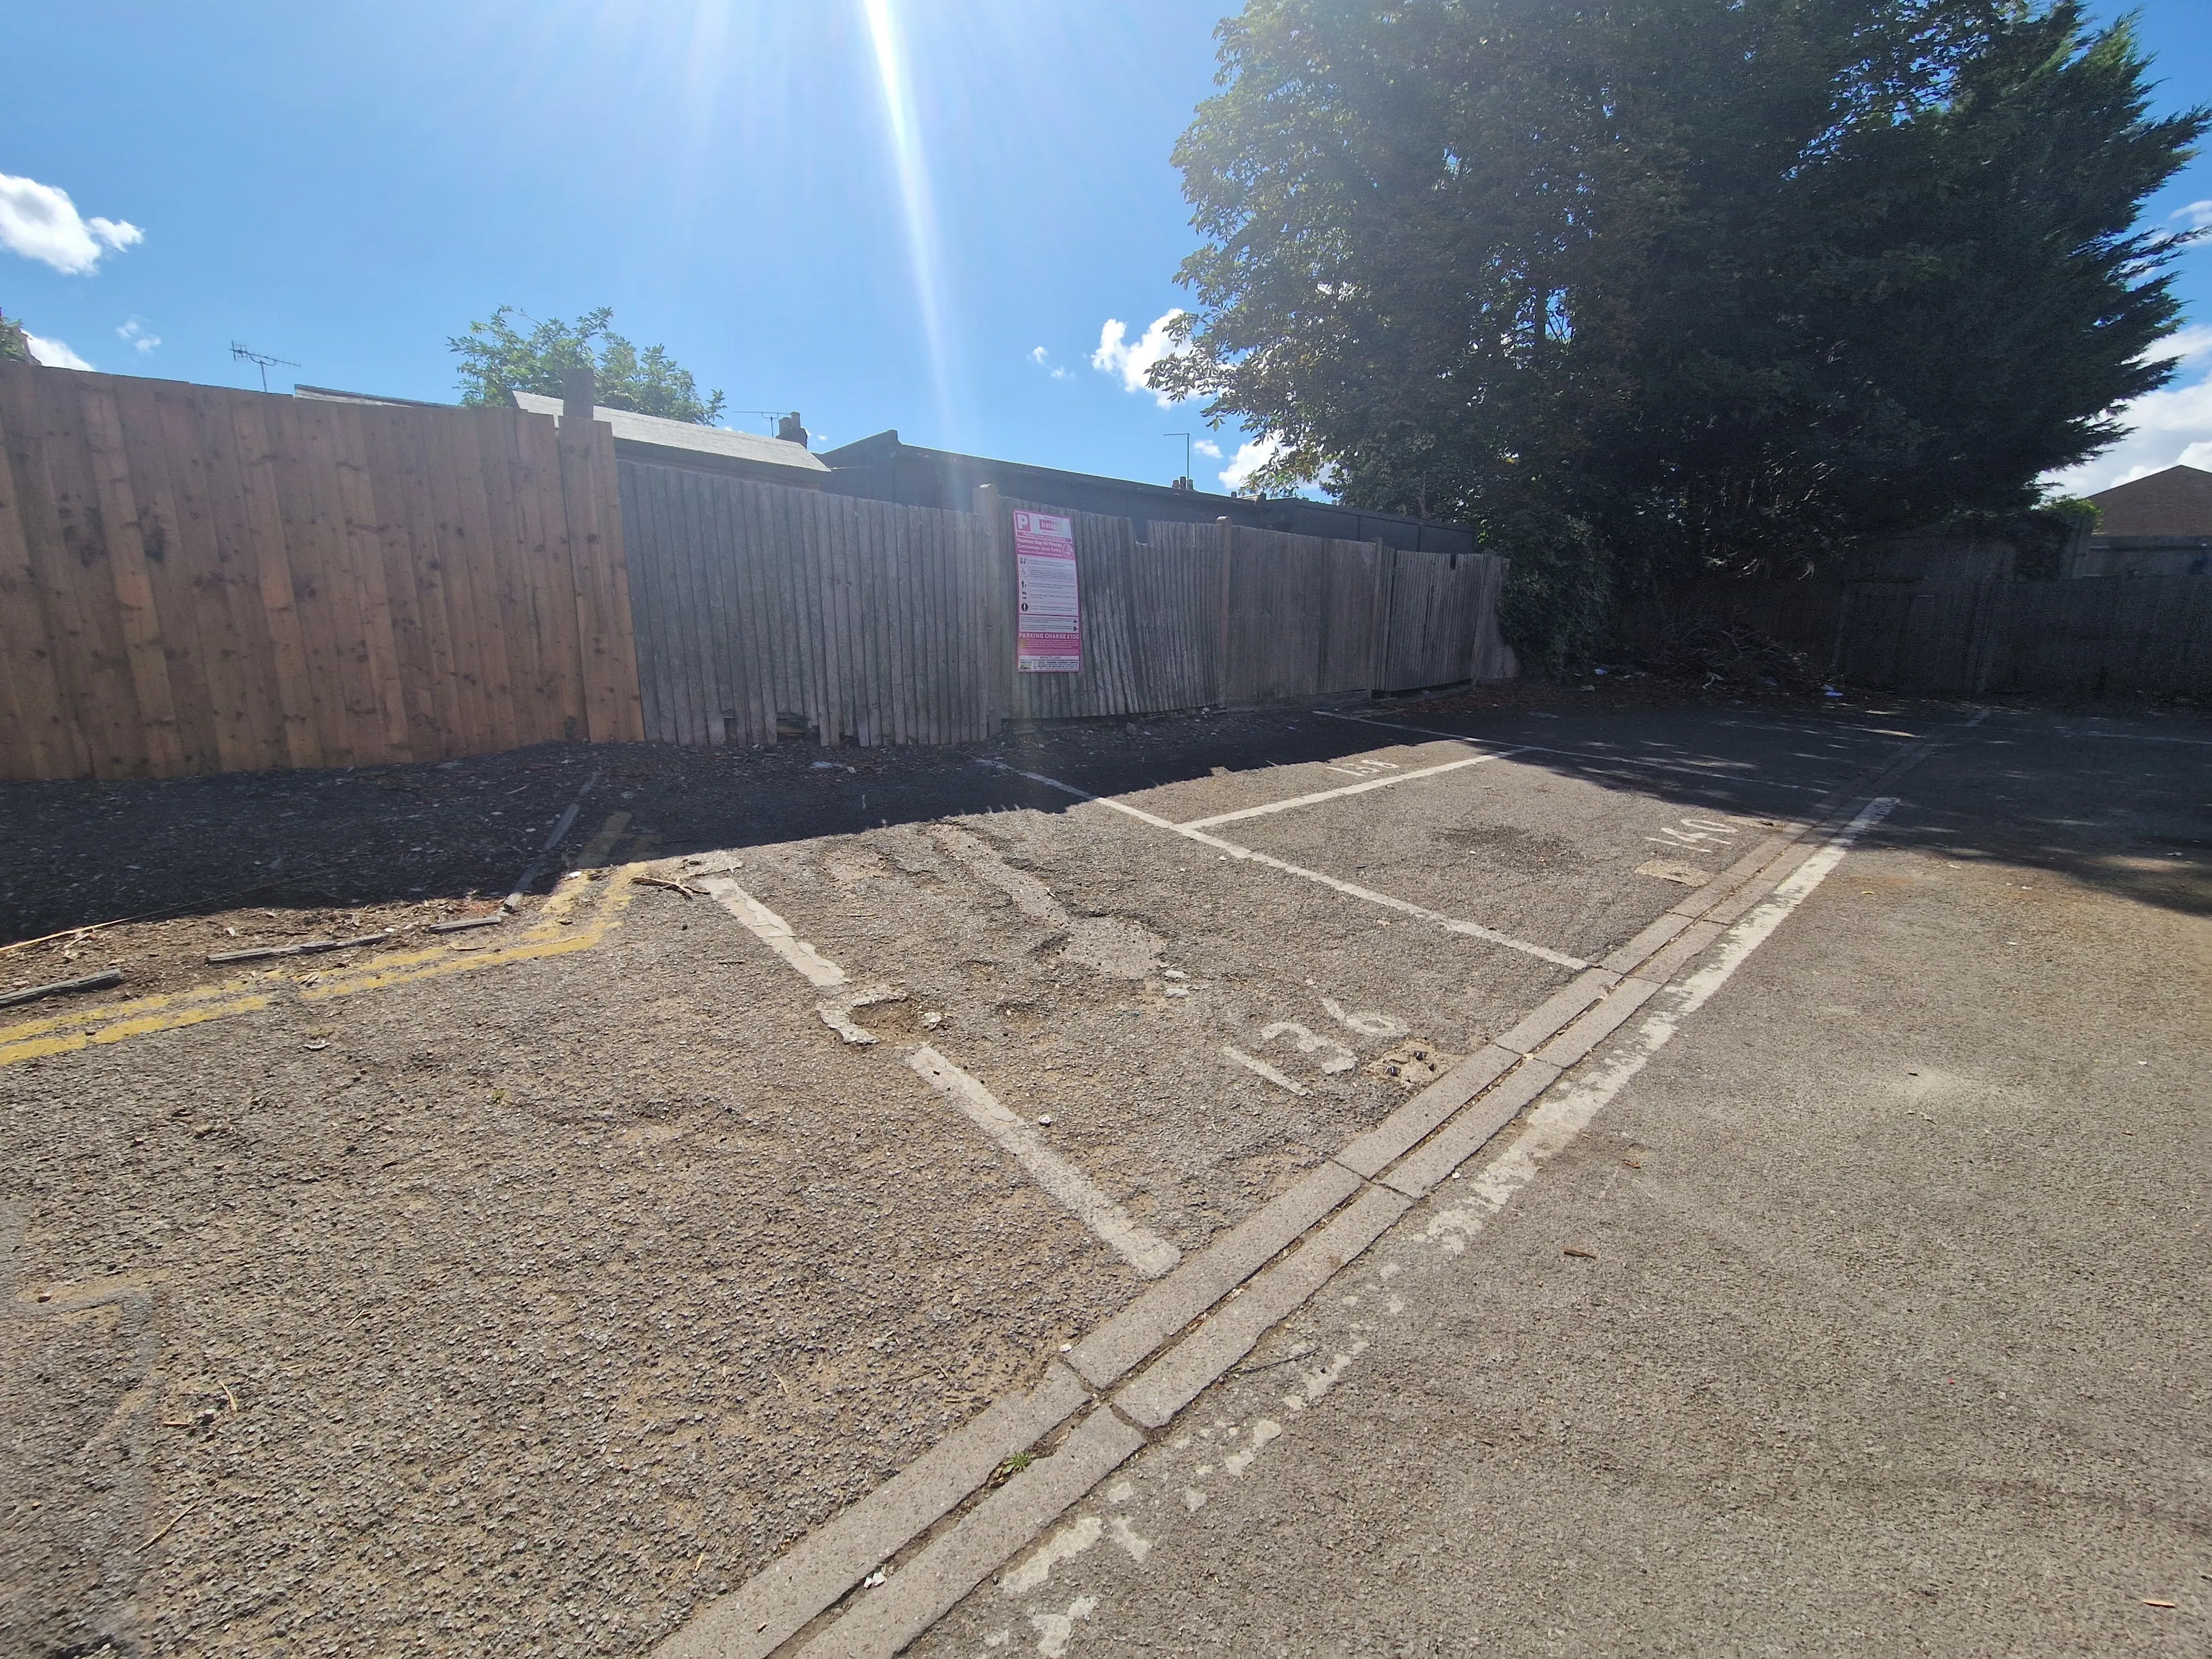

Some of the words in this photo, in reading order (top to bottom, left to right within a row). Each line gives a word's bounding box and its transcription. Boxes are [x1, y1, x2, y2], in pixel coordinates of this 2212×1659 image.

[1017, 514, 1028, 529] P
[1041, 520, 1059, 531] Icela
[1644, 819, 1738, 853] 140
